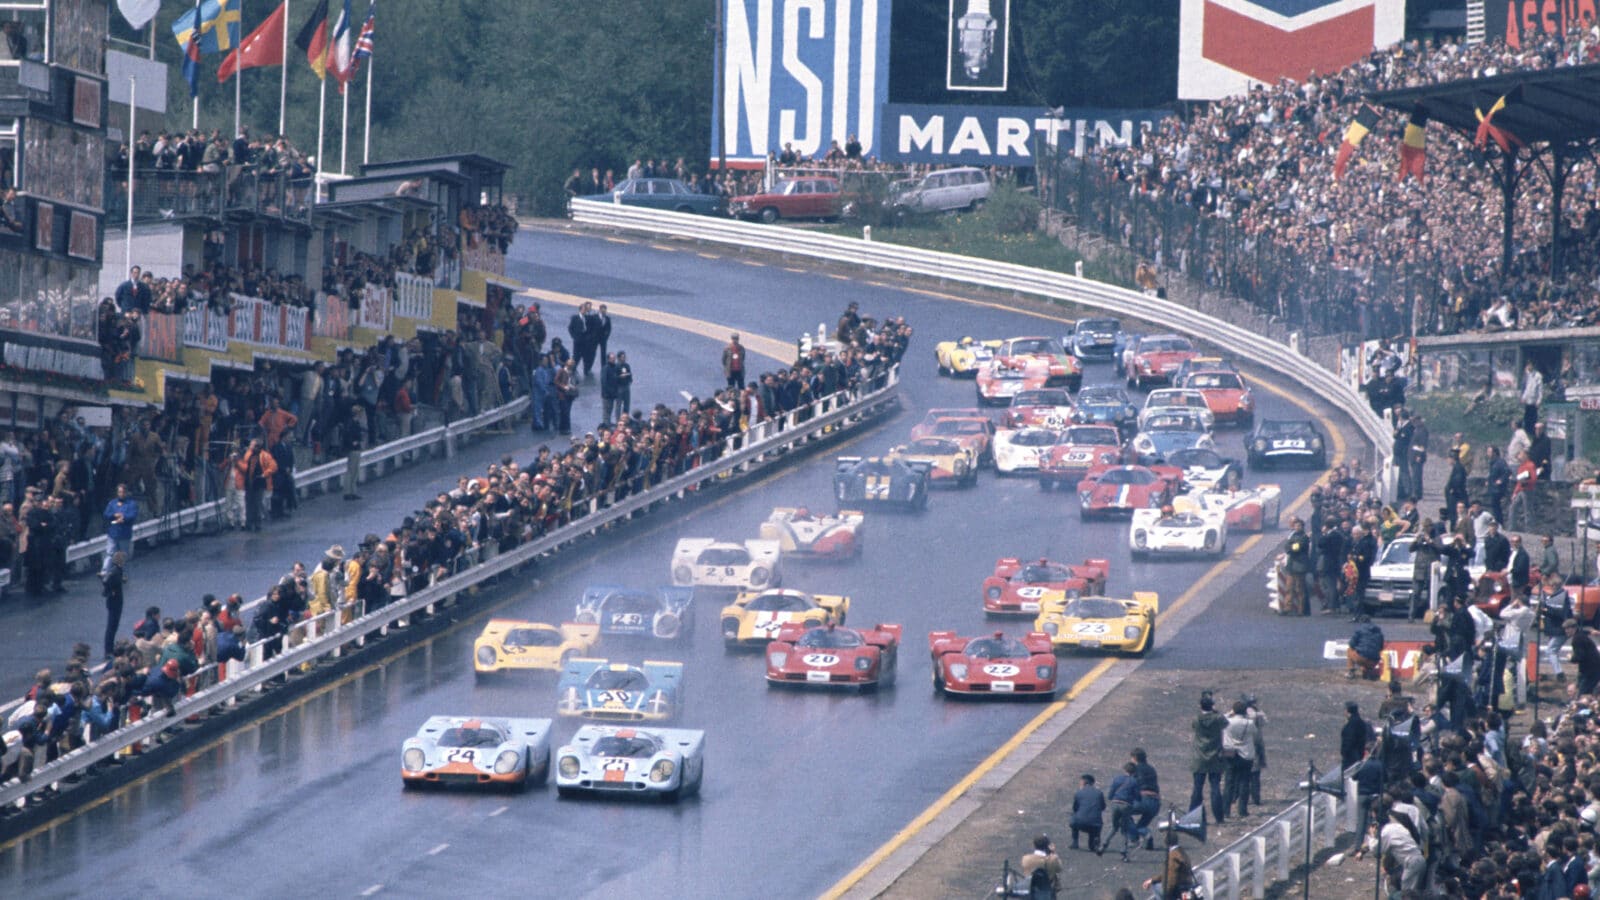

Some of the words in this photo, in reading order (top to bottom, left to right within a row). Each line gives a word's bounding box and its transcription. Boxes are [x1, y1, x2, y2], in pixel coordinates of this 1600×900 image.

[726, 0, 876, 157] NSU
[1068, 453, 1087, 461] 59
[809, 654, 835, 663] 20
[988, 665, 1012, 674] 22
[447, 749, 475, 762] 24
